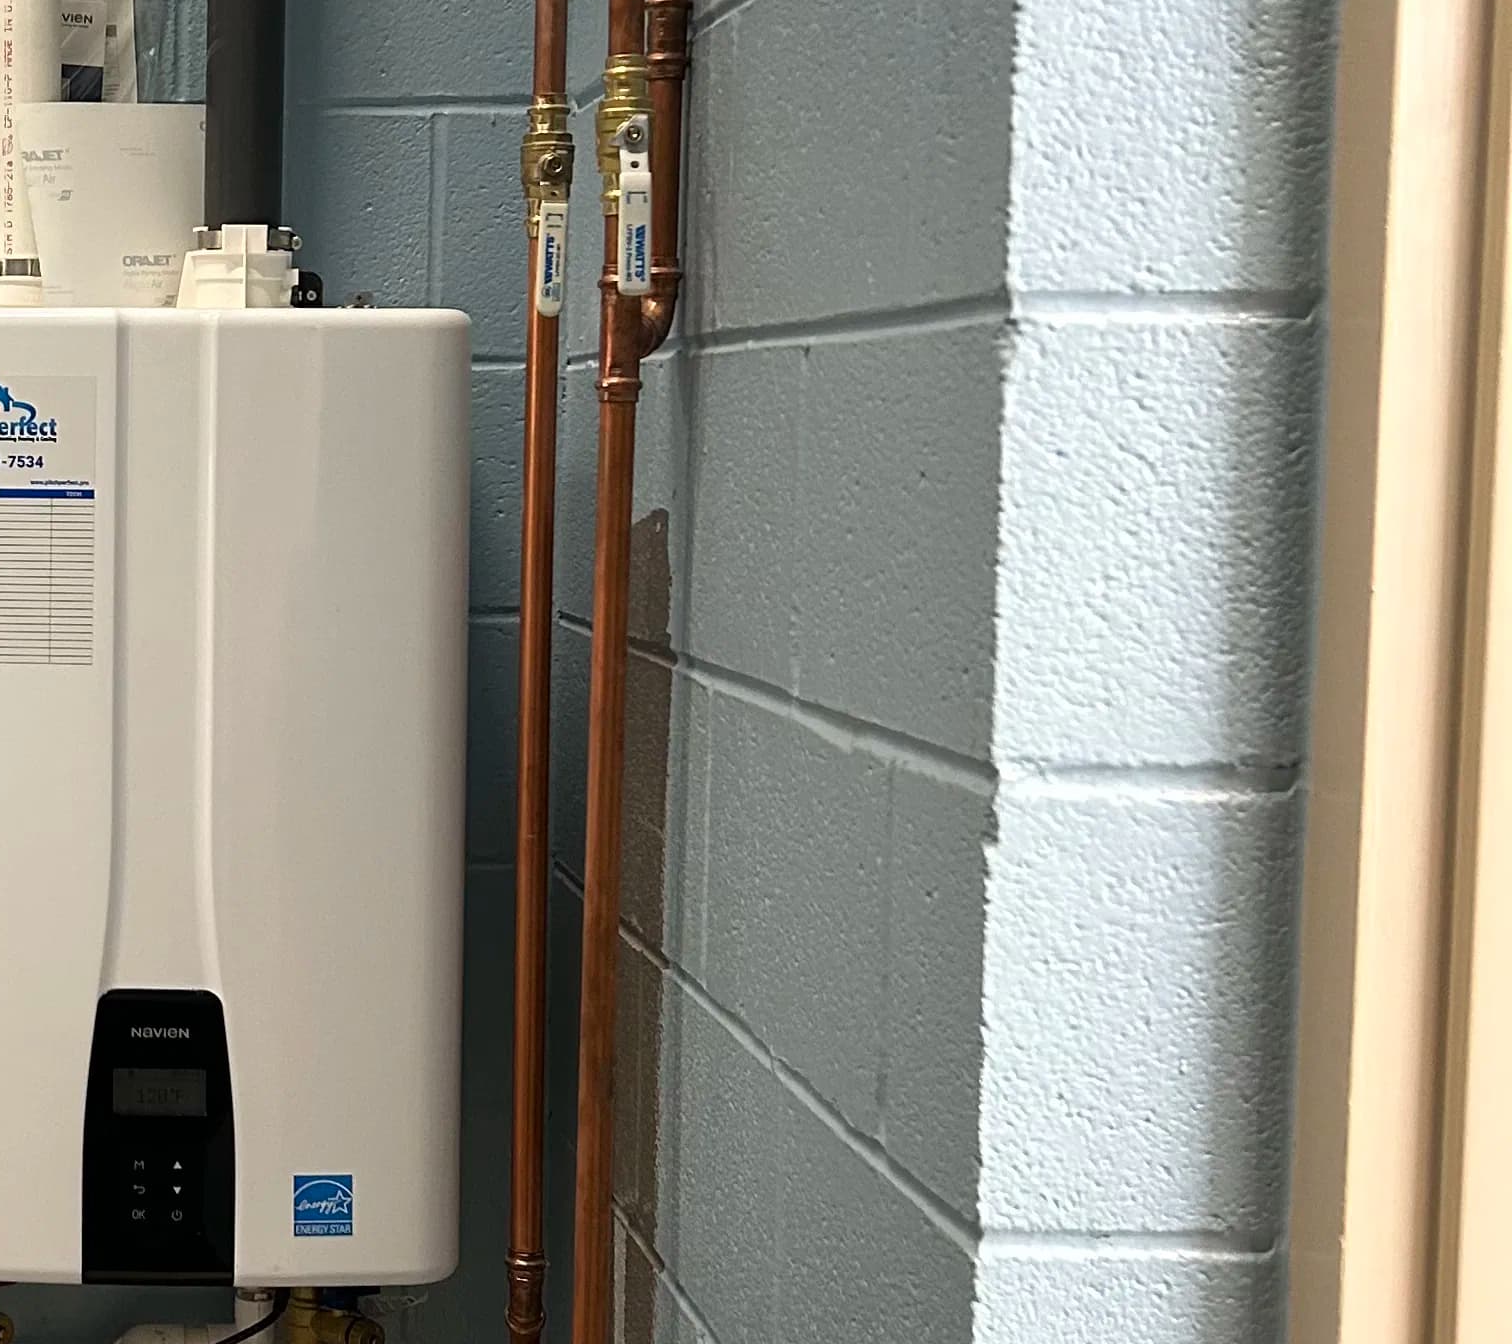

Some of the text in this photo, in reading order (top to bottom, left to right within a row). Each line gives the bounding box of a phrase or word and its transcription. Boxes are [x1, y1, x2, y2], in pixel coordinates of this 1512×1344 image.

[133, 1159, 145, 1170] M
[131, 1208, 146, 1221] OK
[295, 1224, 351, 1235] ENERGY STAR
